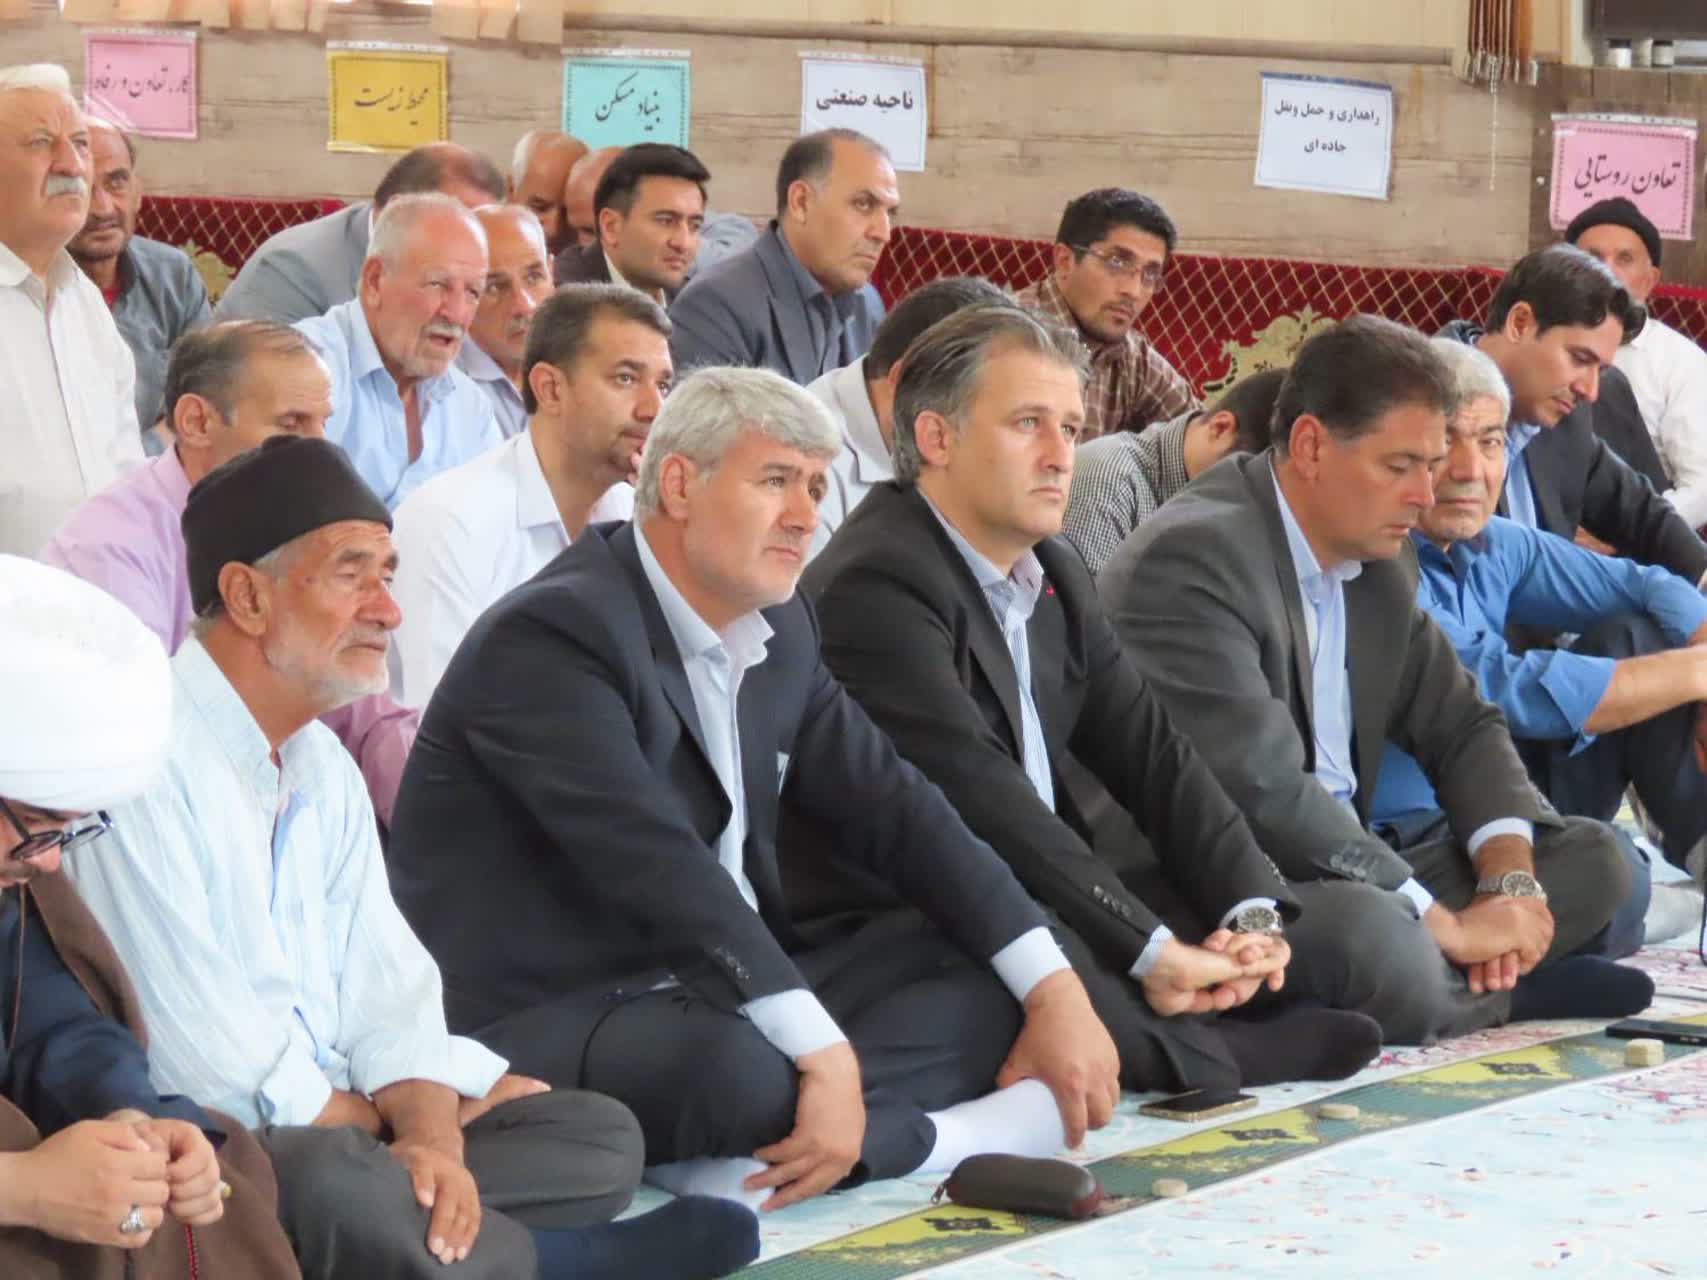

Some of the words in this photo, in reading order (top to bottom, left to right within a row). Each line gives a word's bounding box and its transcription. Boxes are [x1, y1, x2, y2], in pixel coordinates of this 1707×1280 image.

[594, 70, 638, 122] مسکن
[815, 88, 868, 110] صنعتی
[872, 89, 914, 114] ناحیه
[638, 89, 661, 131] بنیاد
[1300, 101, 1325, 118] حمل
[1336, 106, 1380, 126] راهداری
[1303, 138, 1319, 153] ای
[1320, 138, 1347, 155] جاده
[1631, 161, 1682, 194] تعاون
